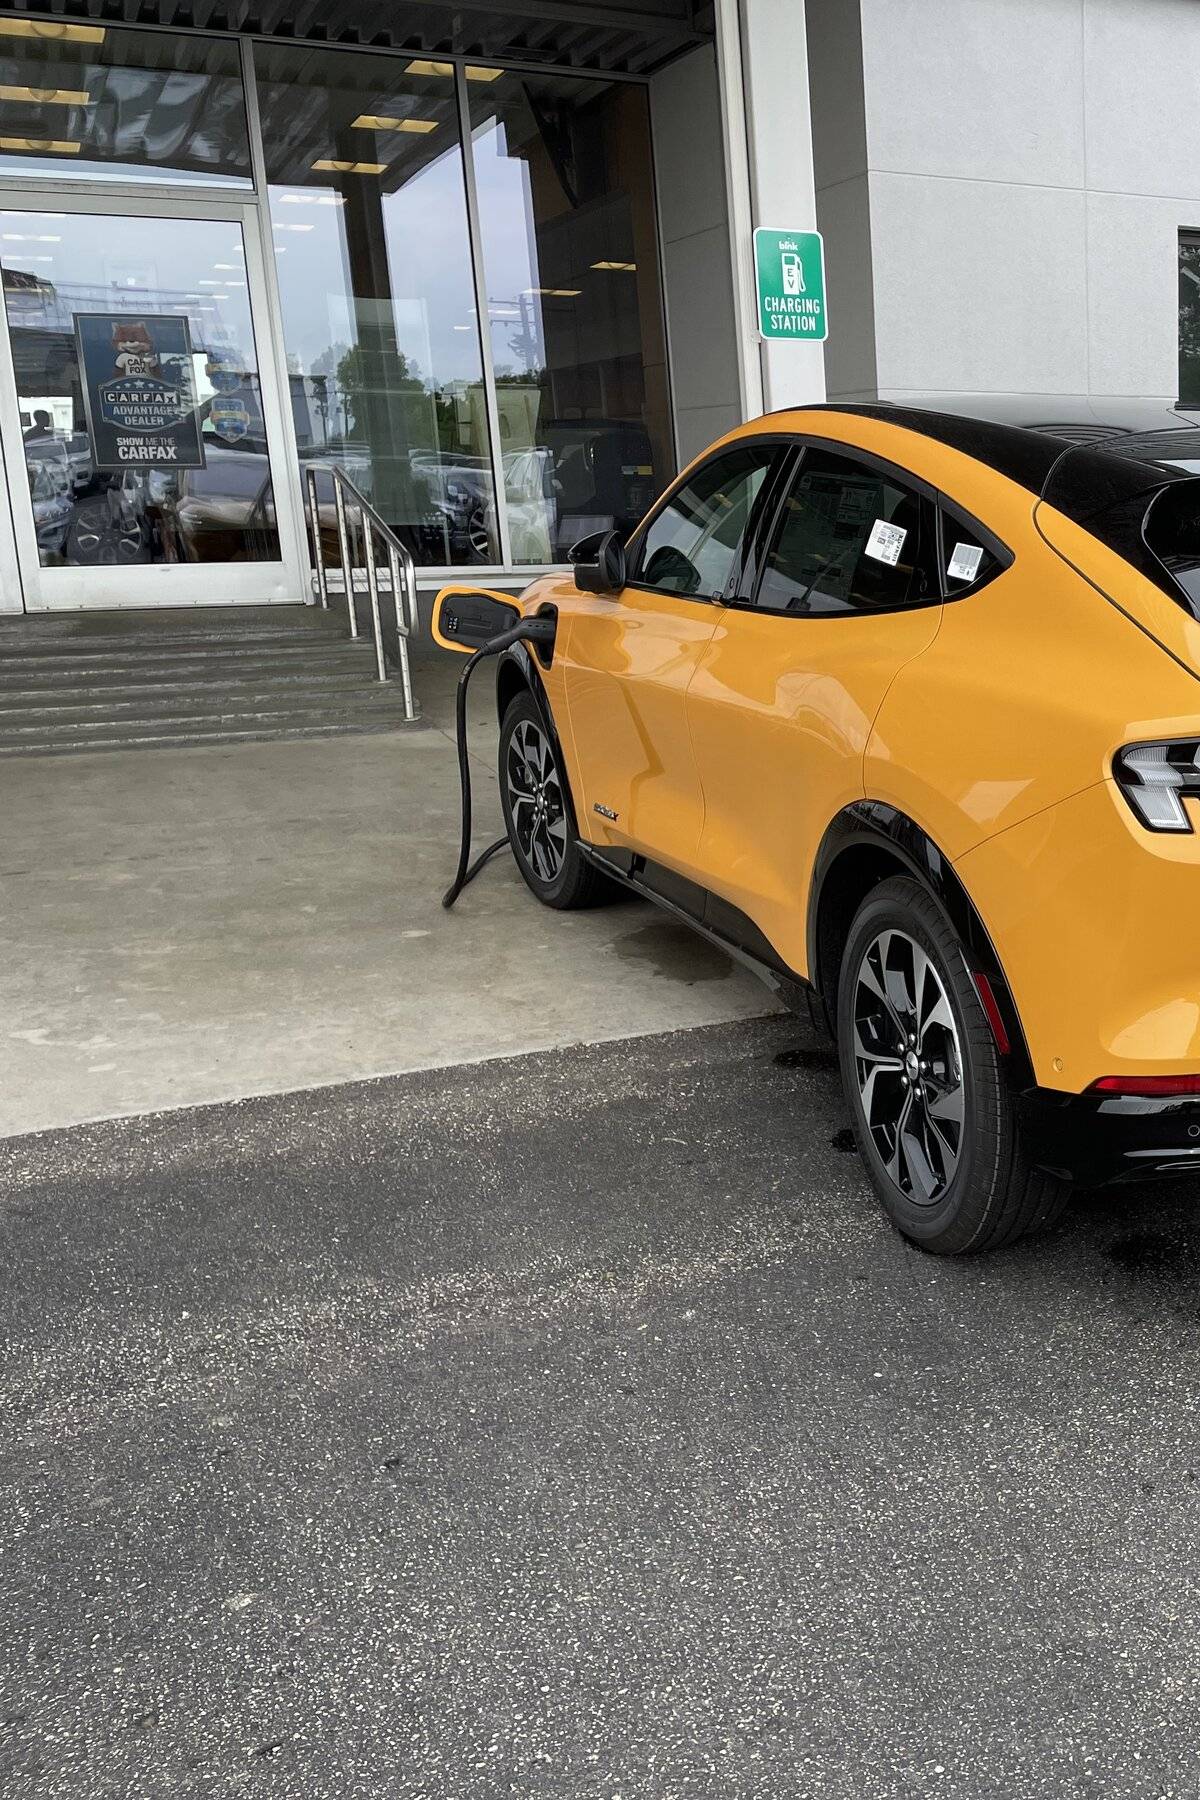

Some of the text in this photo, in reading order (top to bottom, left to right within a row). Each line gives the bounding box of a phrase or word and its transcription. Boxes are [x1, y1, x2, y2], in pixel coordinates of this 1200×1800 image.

[764, 296, 821, 314] CHARGING
[770, 314, 816, 331] STATION
[129, 366, 147, 374] FOX
[107, 393, 175, 403] CARFAX
[113, 405, 174, 415] ADVANTAGE
[124, 416, 164, 425] DEALER
[116, 437, 176, 446] SHOW ME THE
[118, 446, 177, 460] CARFAX
